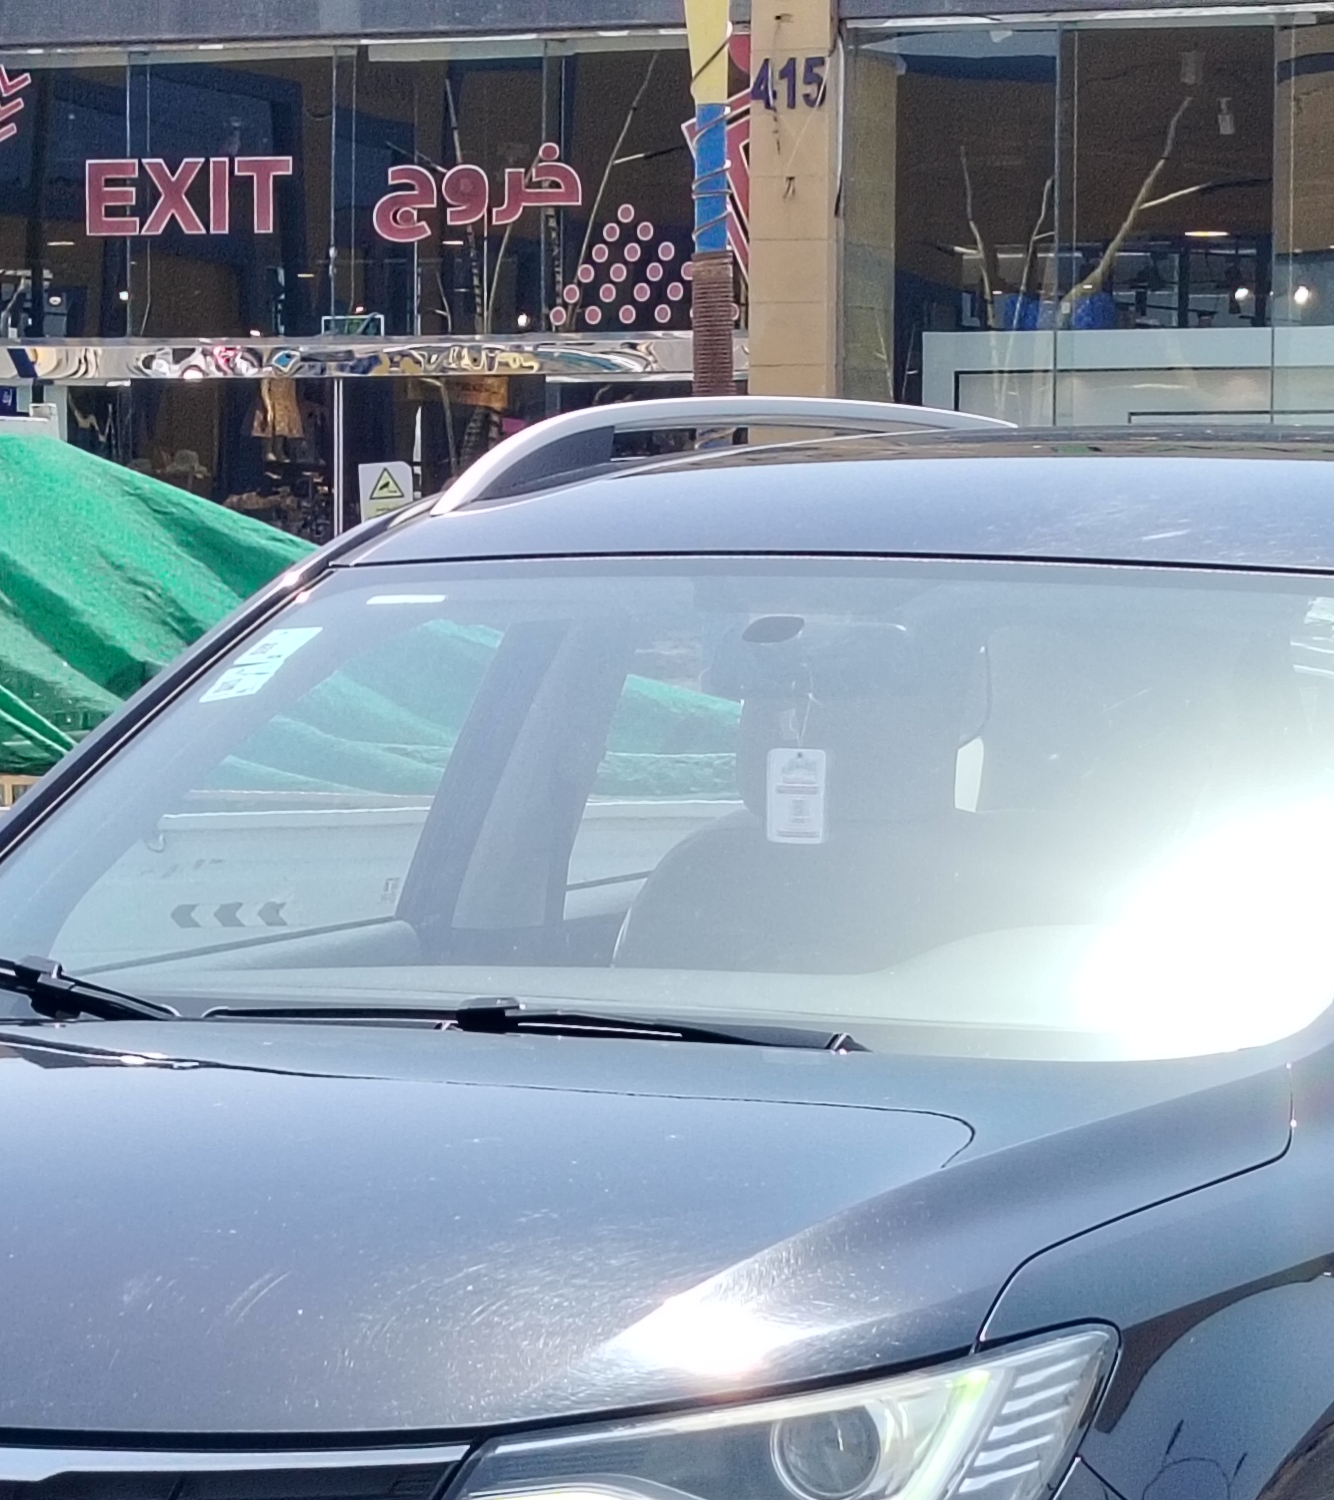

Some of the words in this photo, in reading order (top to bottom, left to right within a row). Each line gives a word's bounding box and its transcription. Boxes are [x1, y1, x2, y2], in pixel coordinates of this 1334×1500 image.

[751, 56, 827, 110] 415
[85, 156, 293, 236] EXIT
[373, 142, 582, 242] خروج
